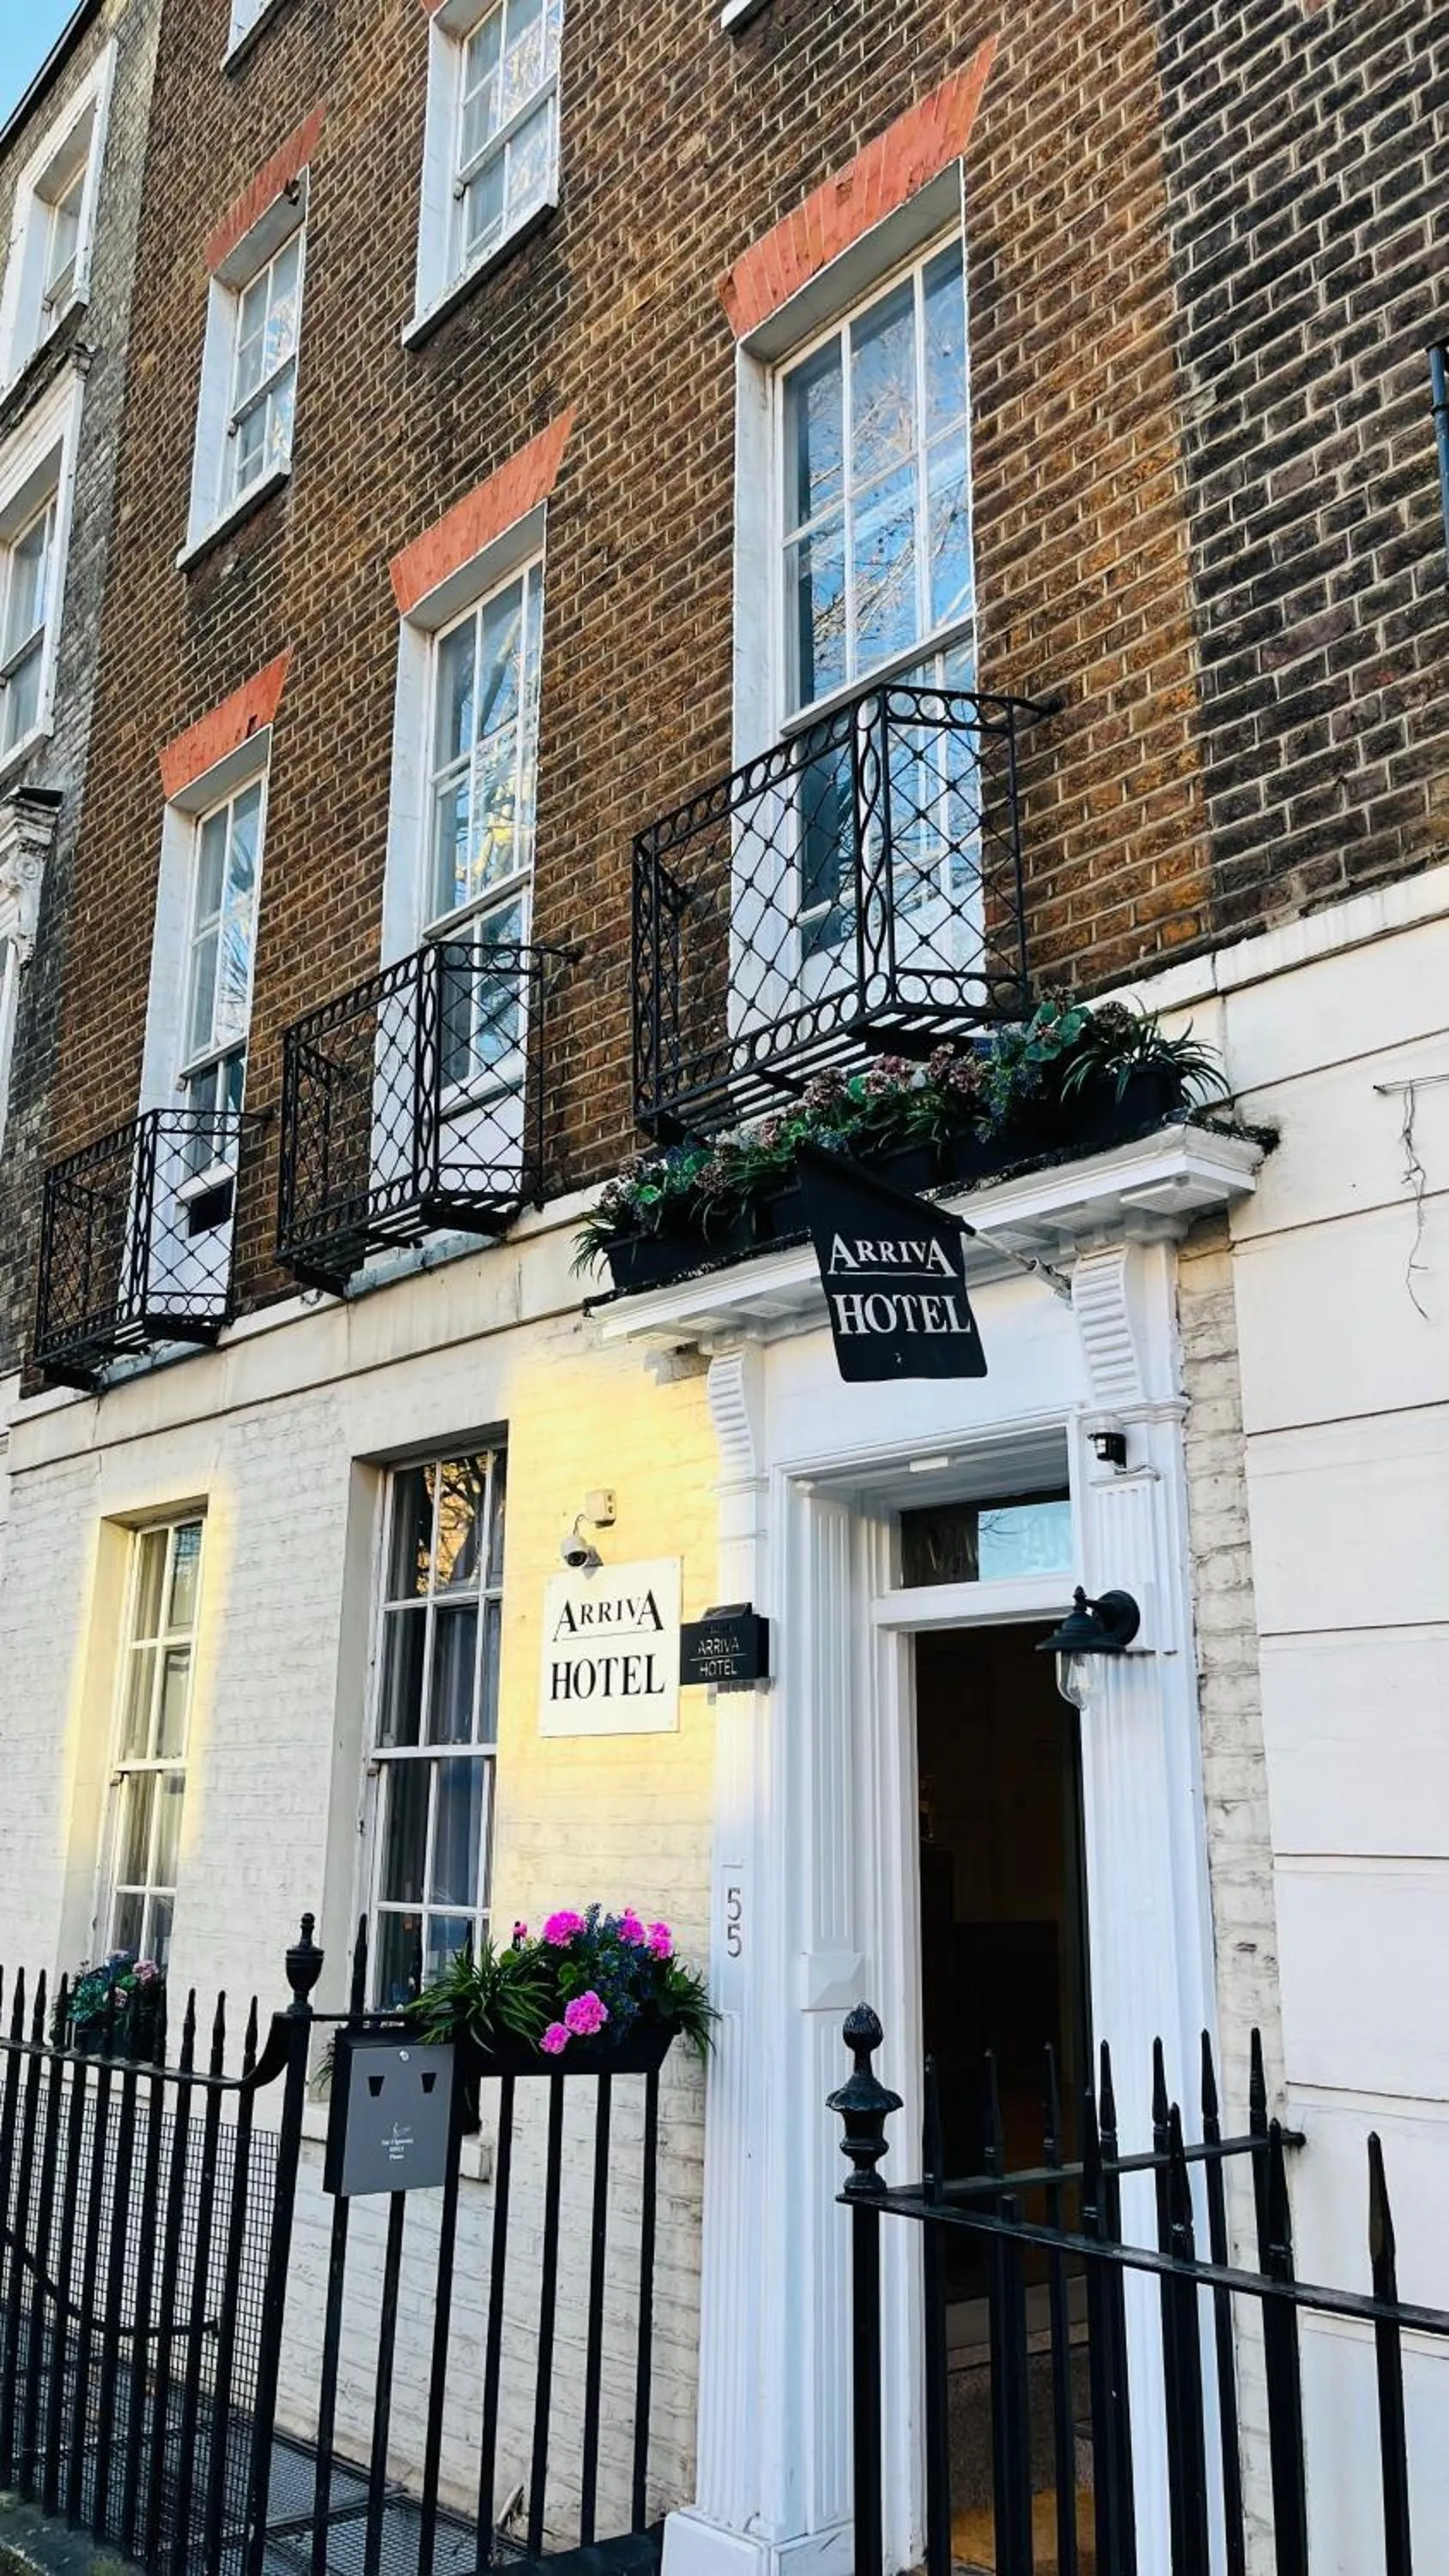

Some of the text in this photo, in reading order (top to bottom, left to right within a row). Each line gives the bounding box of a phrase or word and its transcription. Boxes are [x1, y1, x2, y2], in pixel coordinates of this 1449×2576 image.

[827, 1233, 959, 1277] ARRIVA
[832, 1293, 971, 1334] HOTEL
[552, 1589, 664, 1642] ARRIVA
[698, 1637, 740, 1656] ARRIVA
[700, 1658, 737, 1677] HOTEL
[550, 1653, 666, 1700] HOTEL
